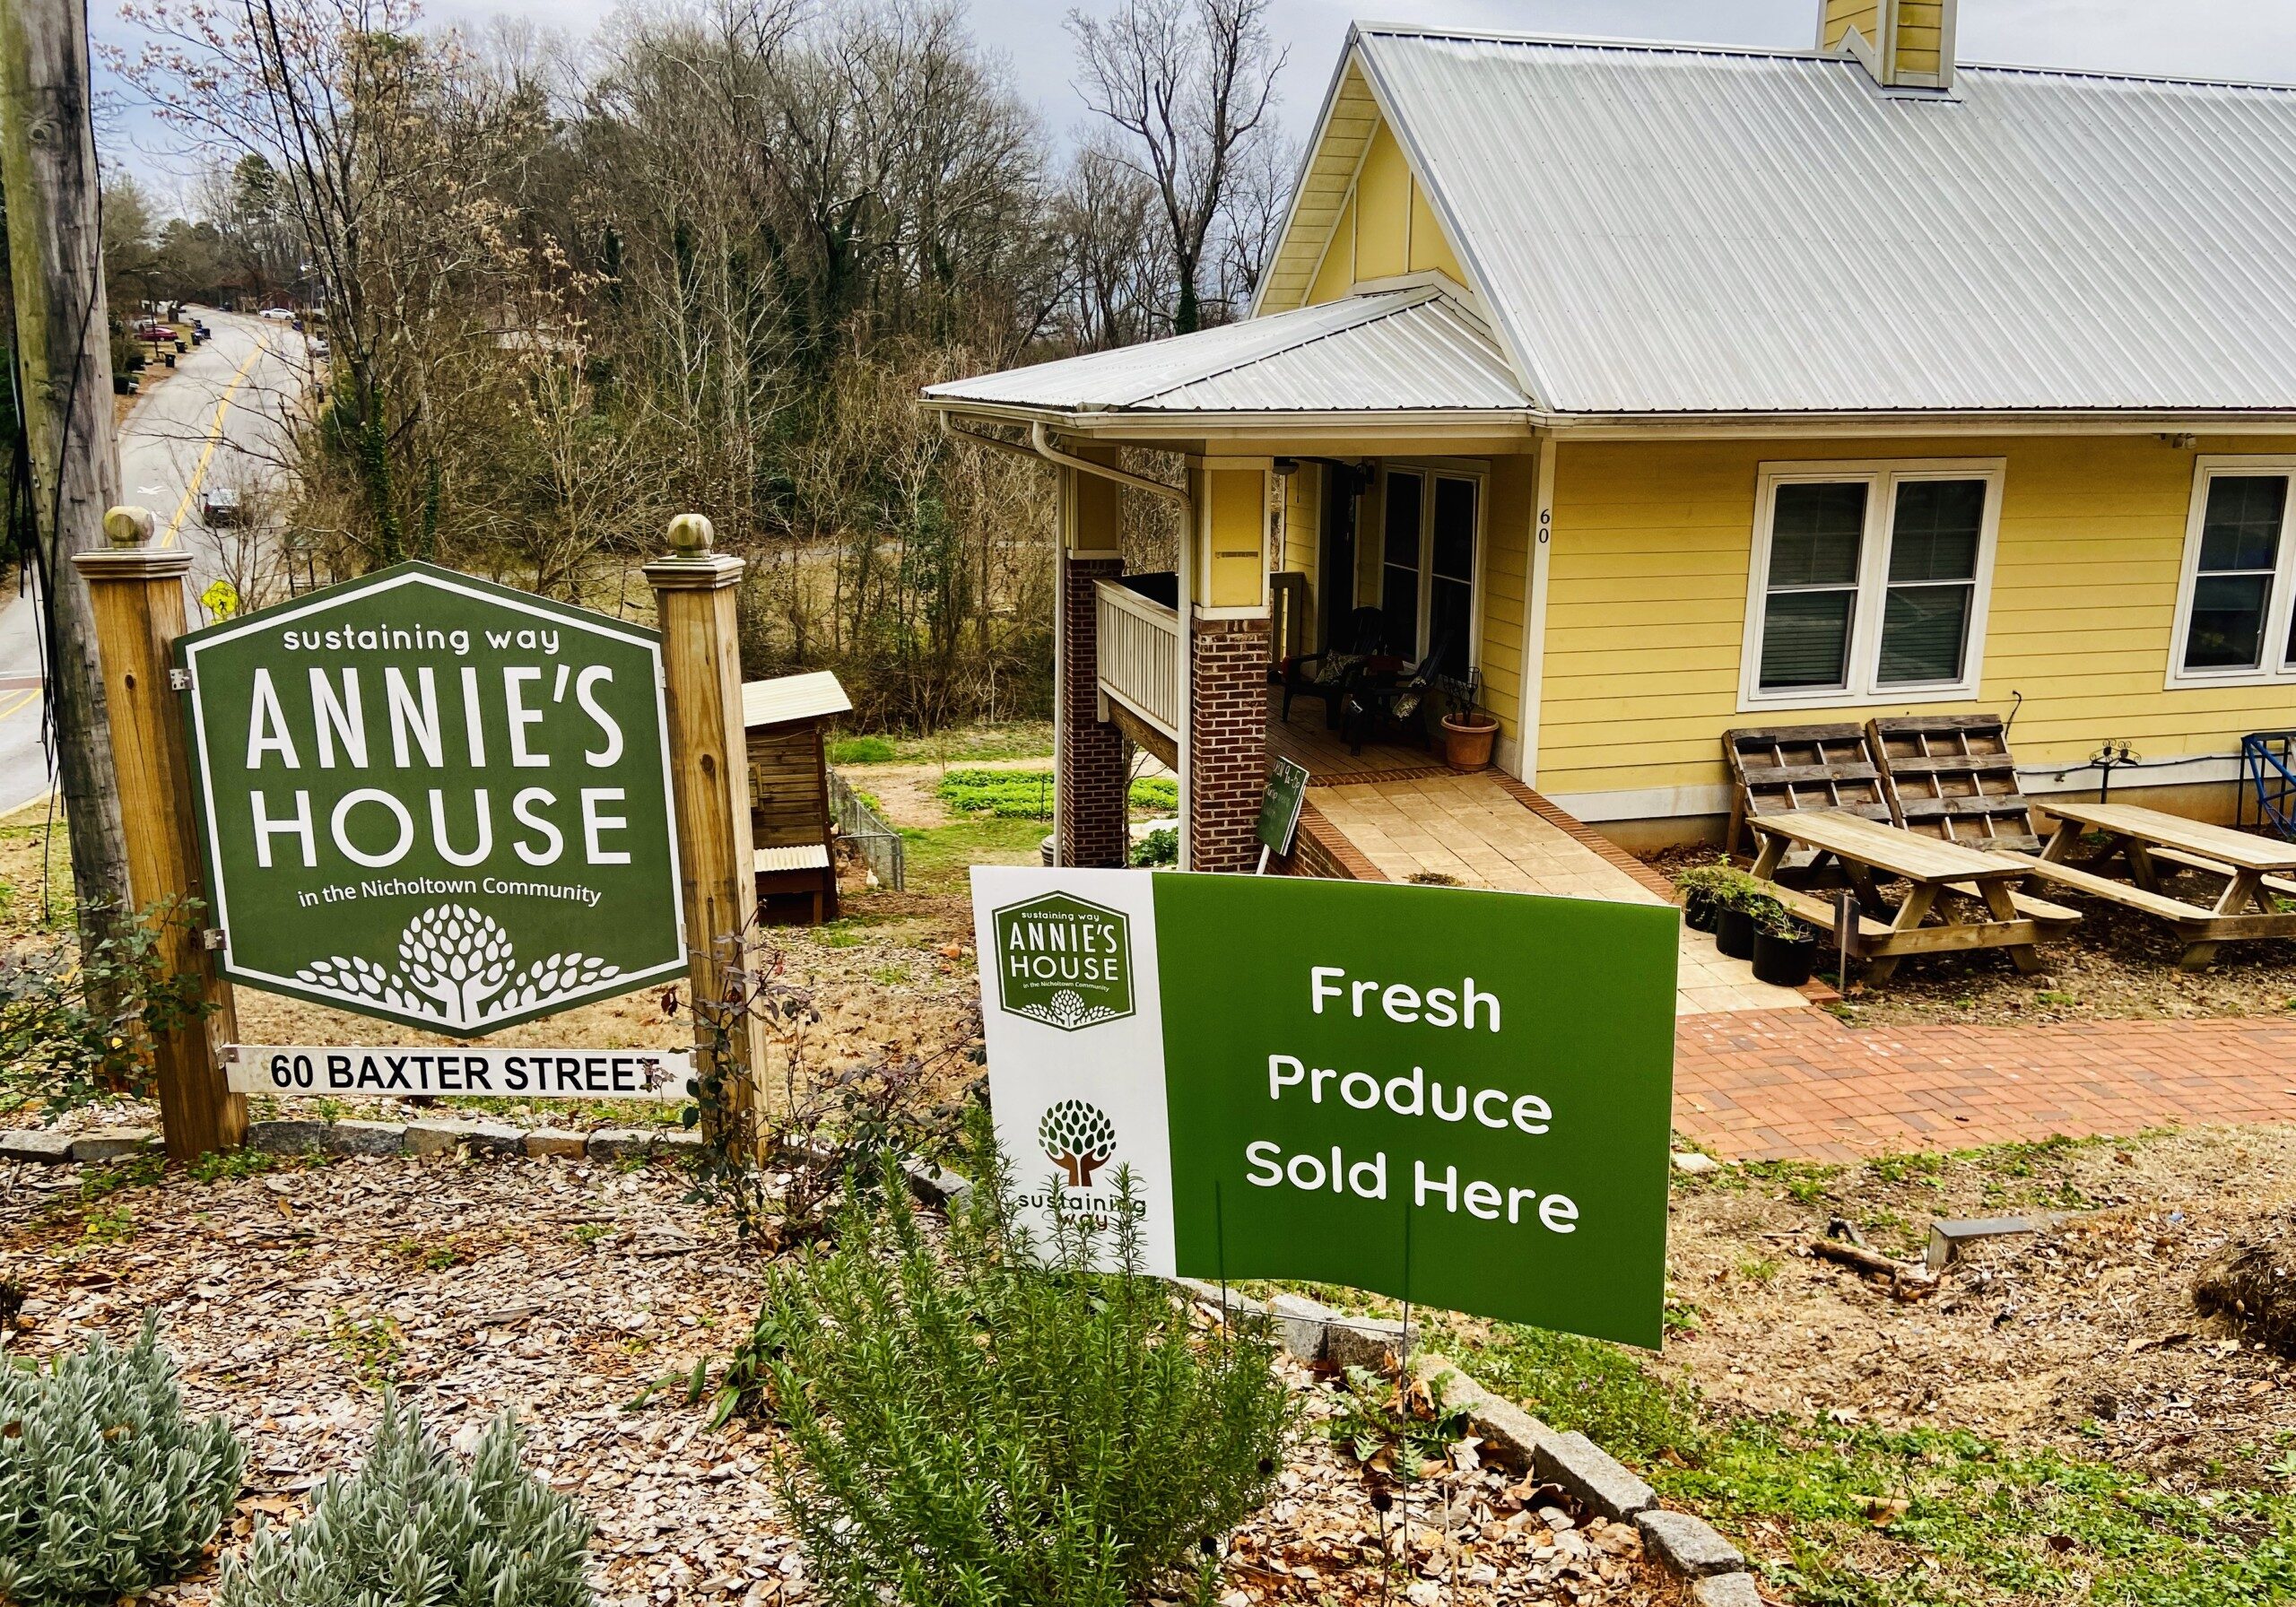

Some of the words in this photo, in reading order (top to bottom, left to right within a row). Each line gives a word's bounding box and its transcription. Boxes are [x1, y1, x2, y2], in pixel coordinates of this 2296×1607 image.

[1539, 508, 1550, 543] 60
[283, 623, 470, 656] sustaining
[484, 626, 561, 656] way
[246, 663, 625, 769] ANNIE'S
[249, 786, 632, 868] HOUSE
[297, 890, 319, 908] in
[321, 884, 357, 903] the
[361, 876, 477, 898] Nicholtown
[483, 877, 602, 908] Community
[1021, 910, 1074, 921] sustaining
[1078, 914, 1100, 922] way
[1009, 922, 1118, 953] ANNIE'S
[1010, 955, 1118, 981] HOUSE
[1074, 981, 1110, 992] Community
[1310, 966, 1501, 1033] Fresh
[270, 1055, 314, 1089] 60
[326, 1055, 491, 1090] BAXTER
[1267, 1054, 1553, 1135] Produce
[1245, 1140, 1387, 1201] Sold
[1413, 1160, 1580, 1234] Here
[1018, 1193, 1146, 1218] sustainig
